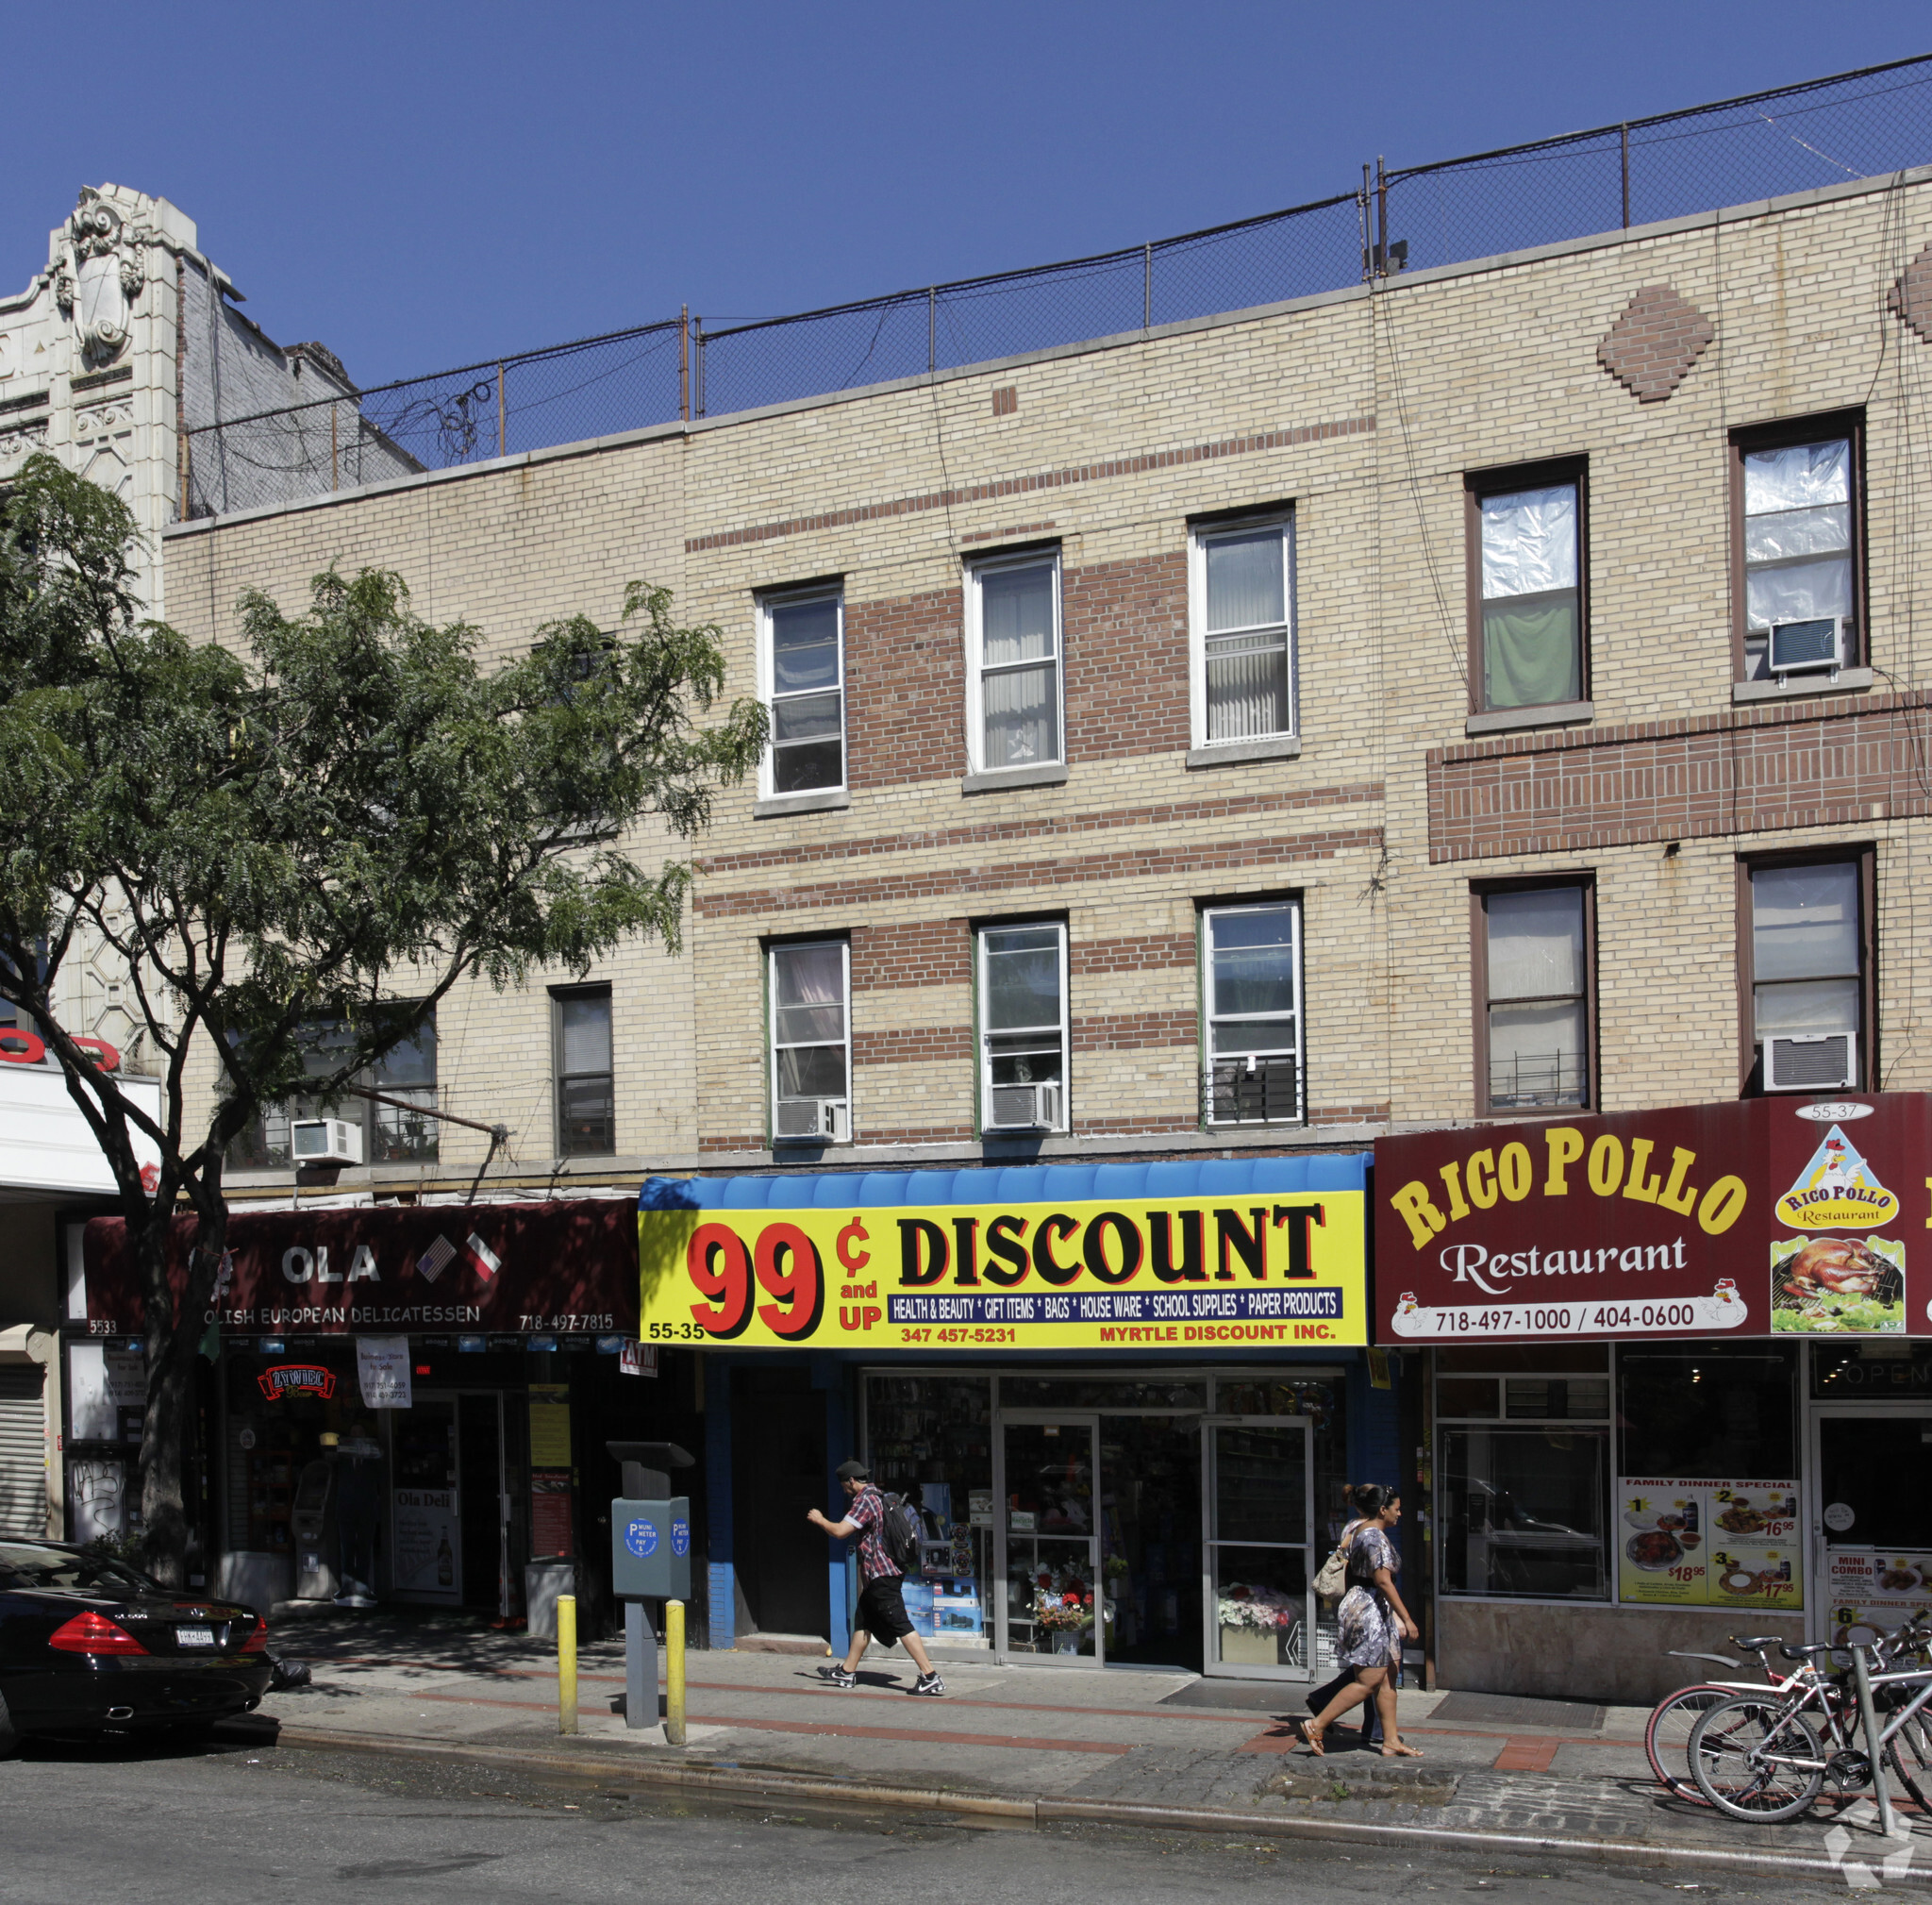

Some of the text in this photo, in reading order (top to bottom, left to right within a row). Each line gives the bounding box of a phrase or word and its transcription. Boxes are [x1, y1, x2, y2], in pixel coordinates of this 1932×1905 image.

[1811, 1104, 1857, 1119] 55-37
[1390, 1127, 1747, 1251] RICO POLLO
[1785, 1185, 1891, 1212] RICO POLLO
[1797, 1210, 1880, 1226] Restaurant
[897, 1203, 1325, 1287] DISCOUNT
[281, 1245, 382, 1284] OLA
[1440, 1235, 1688, 1295] Restaurant
[687, 1222, 824, 1341] 99
[841, 1280, 877, 1299] and
[893, 1292, 1336, 1320] HEALTH & BEAUTY GIFT ITEMS BAGS HOUSE WARE SCHOOL SUPPLIES PAPER PRODUCTS
[260, 1307, 345, 1325] EUROPEAN
[351, 1306, 480, 1323] DELICATESSEN
[519, 1313, 613, 1331] 718-497-7815
[840, 1306, 882, 1330] UP
[1436, 1308, 1571, 1331] 718-497-1000
[1593, 1304, 1694, 1328] 404-0600
[90, 1319, 117, 1334] 5533
[649, 1322, 705, 1339] 55-35
[901, 1328, 1016, 1343] 347 457-5231
[1100, 1324, 1336, 1342] MYRTLE DISCOUNT INC.
[626, 1341, 655, 1367] ATM
[1845, 1364, 1928, 1385] OPEN
[1678, 1479, 1731, 1488] DINNER
[397, 1492, 450, 1508] Ola Deli
[1632, 1498, 1641, 1512] 1
[1719, 1490, 1731, 1503] 2
[629, 1523, 639, 1536] P
[1715, 1551, 1727, 1564] 3
[1839, 1557, 1865, 1565] MINI
[1831, 1565, 1873, 1576] COMBO
[1838, 1607, 1853, 1624] 6
